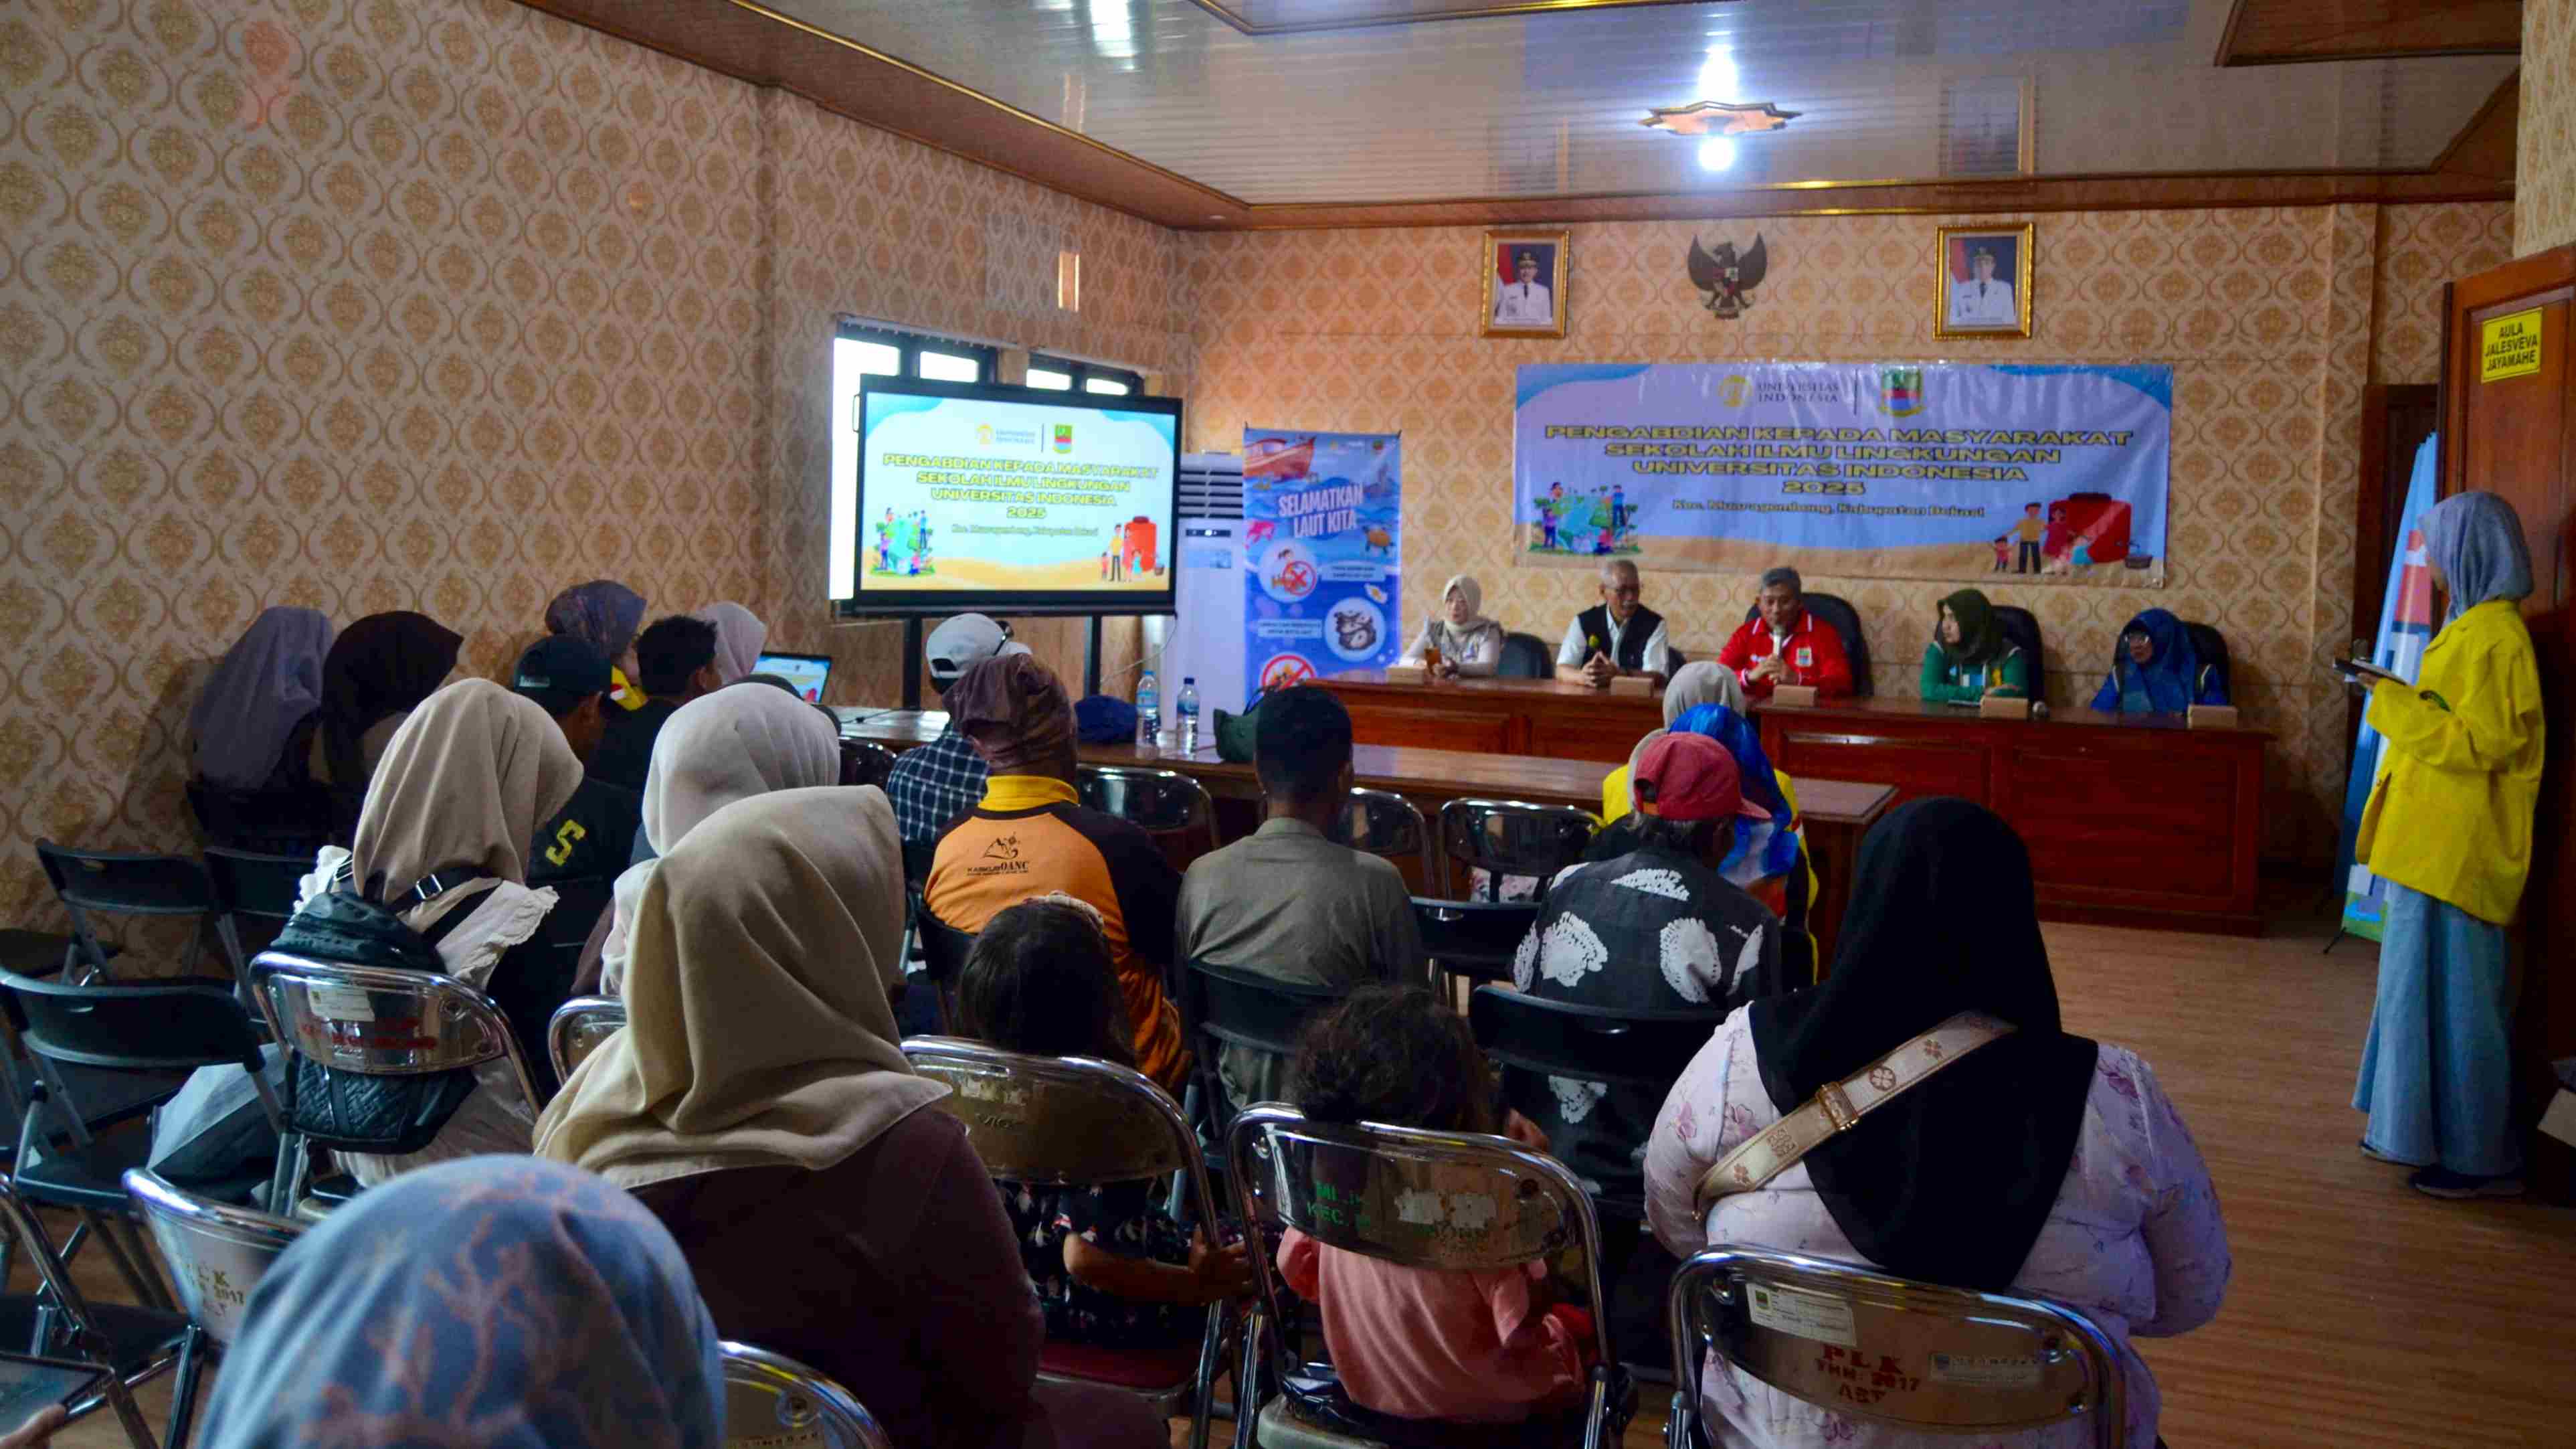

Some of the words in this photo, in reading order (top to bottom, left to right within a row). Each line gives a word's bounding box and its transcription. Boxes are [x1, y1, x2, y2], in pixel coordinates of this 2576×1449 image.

[2499, 322, 2523, 338] AULA
[2484, 334, 2538, 357] JALESVEVA
[2486, 350, 2535, 371] JAYAMAHE
[1545, 425, 1749, 440] PENGABDIAN
[1752, 427, 1885, 442] KEPADA
[1888, 428, 2133, 446] MASYARAKAT
[883, 453, 991, 471] PENGABDIAN
[993, 458, 1054, 474] KEPADA
[1604, 442, 1751, 458] SEKOLAH
[1754, 444, 1832, 459] ILMU
[1835, 446, 2061, 464] LINGKUNGAN
[1632, 460, 1840, 477] UNIVERSITAS
[1843, 462, 2029, 481] INDONESIA
[916, 470, 992, 487] SEKOLAH
[994, 474, 1031, 488] ILMU
[1032, 477, 1131, 493] LINGKUNGAN
[1781, 481, 1866, 495] 2025
[930, 487, 1035, 504] UNIVERSITAS
[1037, 492, 1117, 507] INDONESIA
[1279, 485, 1364, 517] SELAMATKAN
[1006, 506, 1047, 519] 2025
[1295, 512, 1326, 538] LAUT
[1327, 509, 1356, 533] KITA
